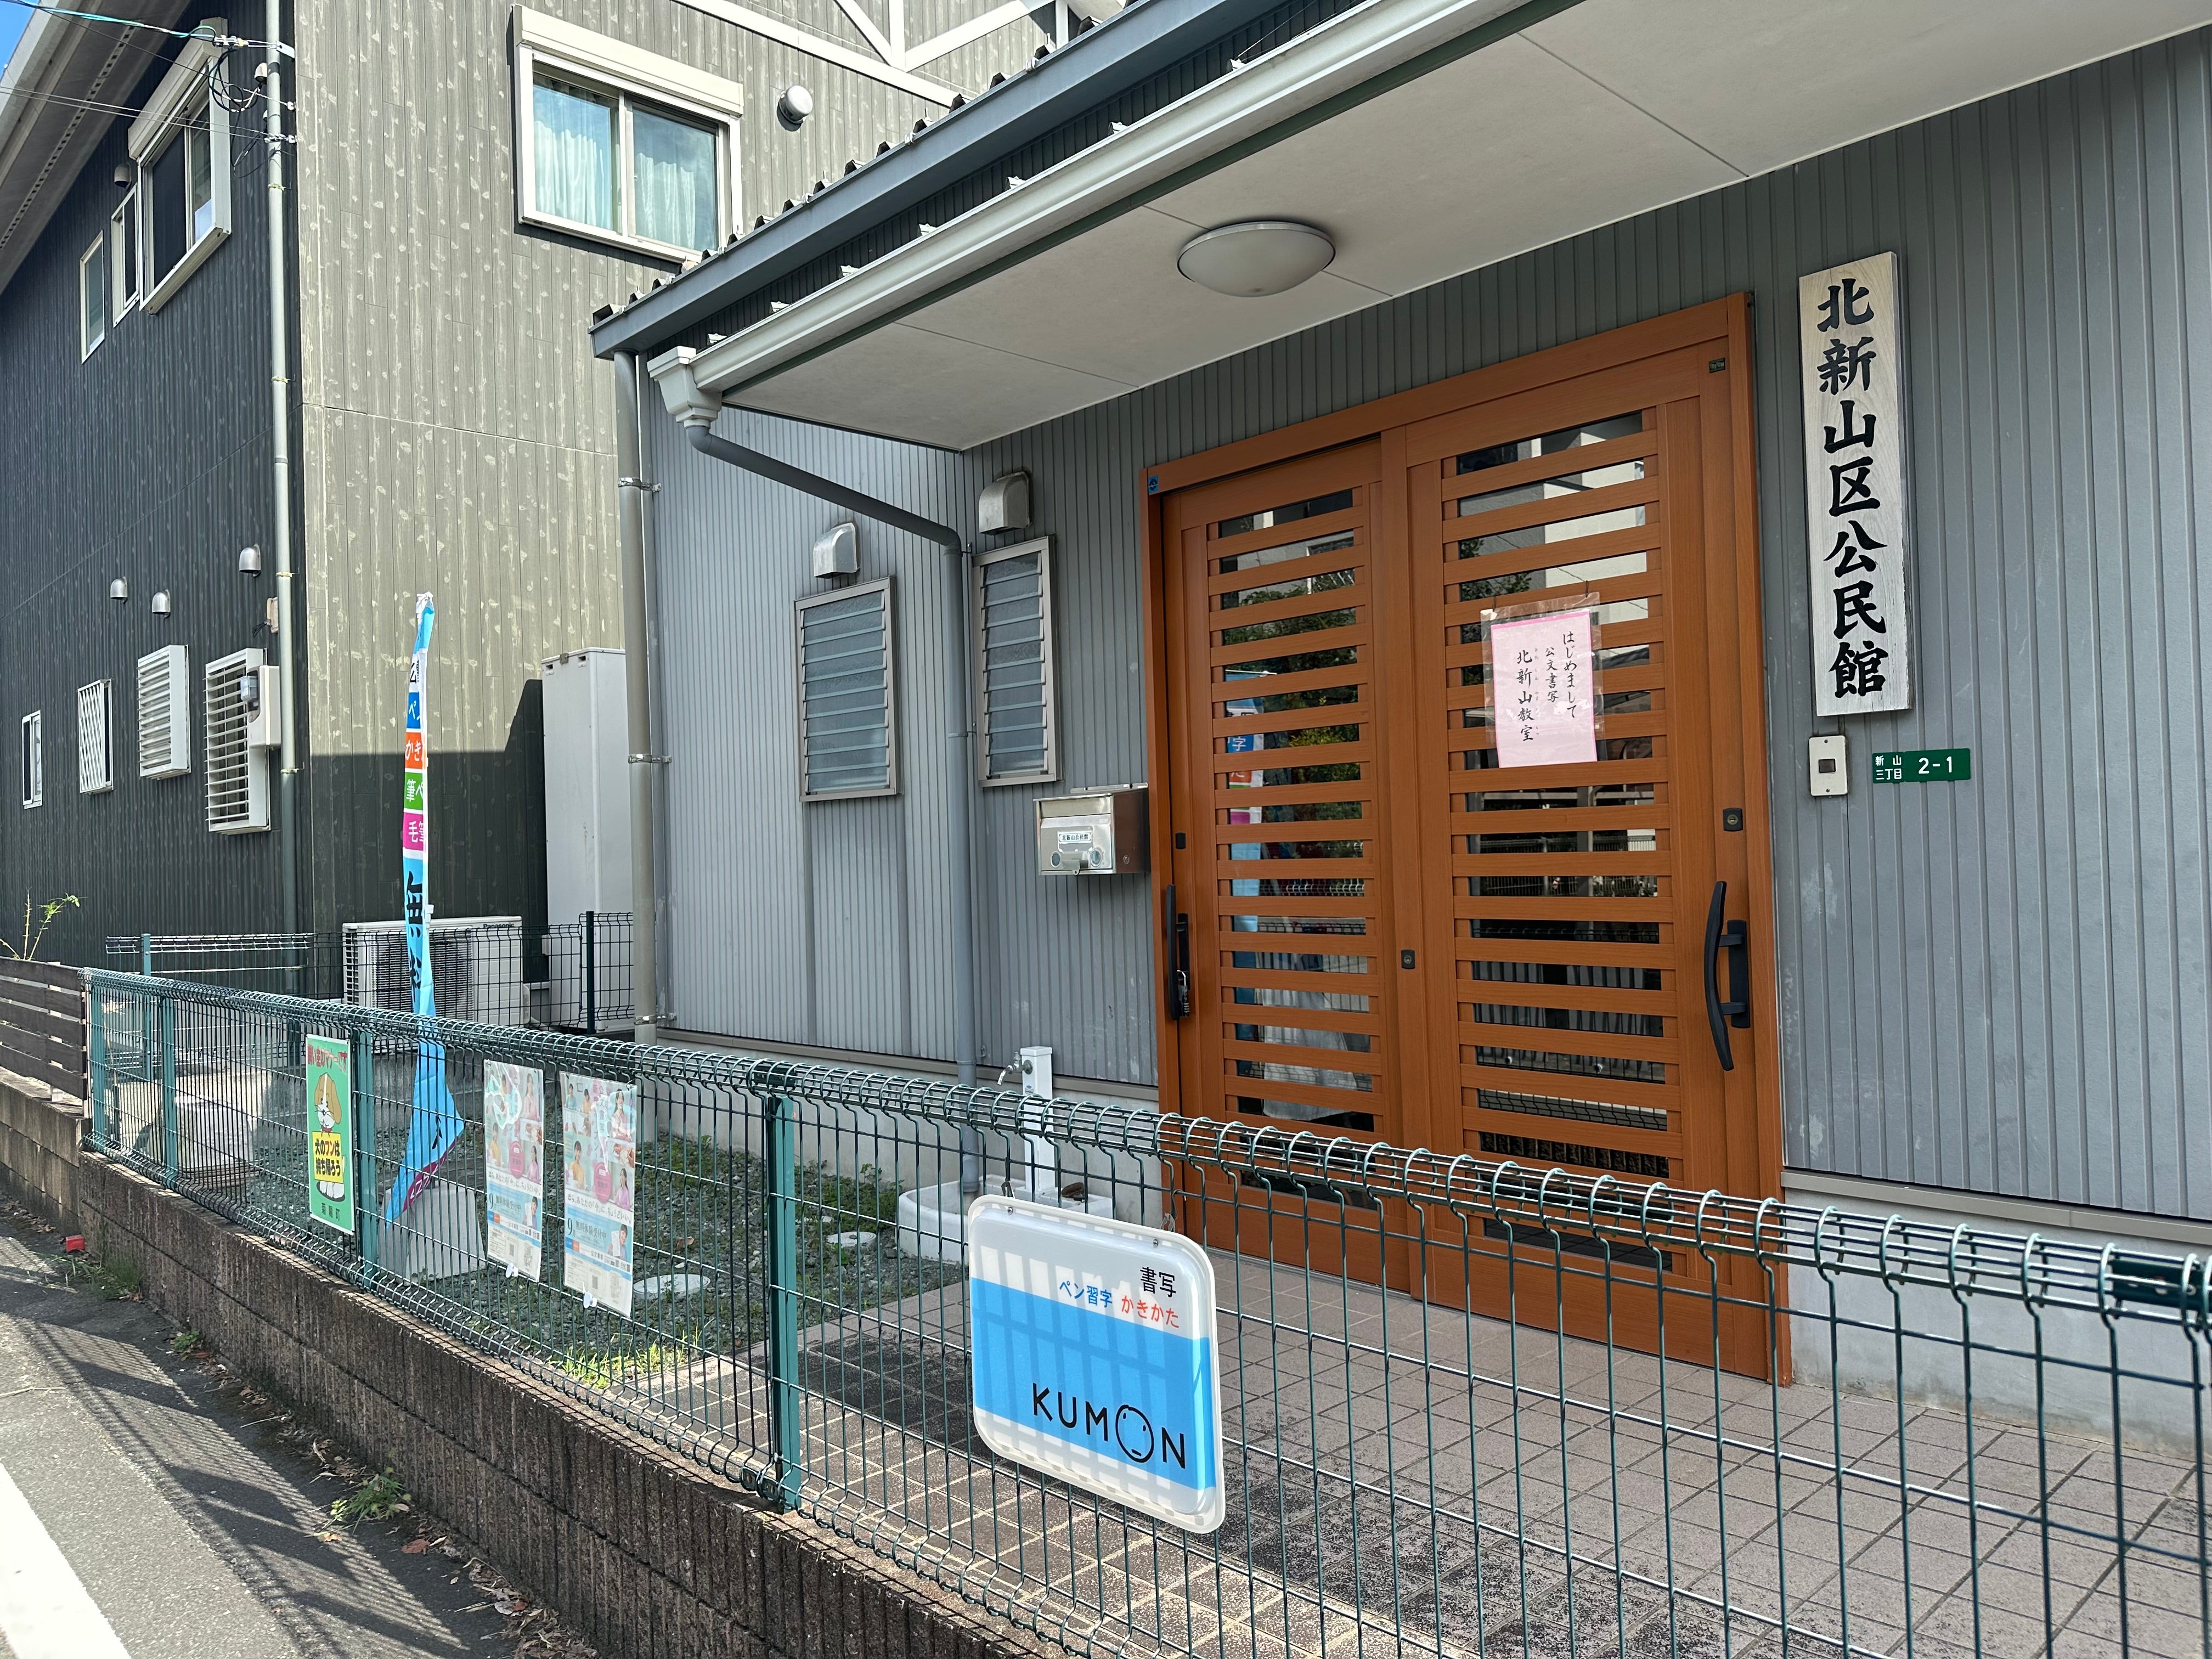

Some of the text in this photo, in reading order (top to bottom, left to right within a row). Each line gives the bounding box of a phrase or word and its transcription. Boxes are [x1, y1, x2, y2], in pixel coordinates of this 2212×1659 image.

[1816, 278, 1888, 699] 北新山区公民館
[1545, 647, 1559, 703] 公文書写
[1563, 631, 1577, 718] はじめまして
[1516, 649, 1535, 742] 北新山教室
[1875, 755, 1901, 766] 新山
[1876, 768, 1902, 780] 三丁目
[1918, 756, 1953, 774] 2-1
[315, 1138, 340, 1157] 犬のフンは
[315, 1157, 341, 1177] 持ち帰ろう
[1059, 1280, 1113, 1308] ペン習字
[1139, 1266, 1177, 1298] 書写
[1121, 1295, 1180, 1329] かきかた
[1032, 1383, 1186, 1469] KUMON
